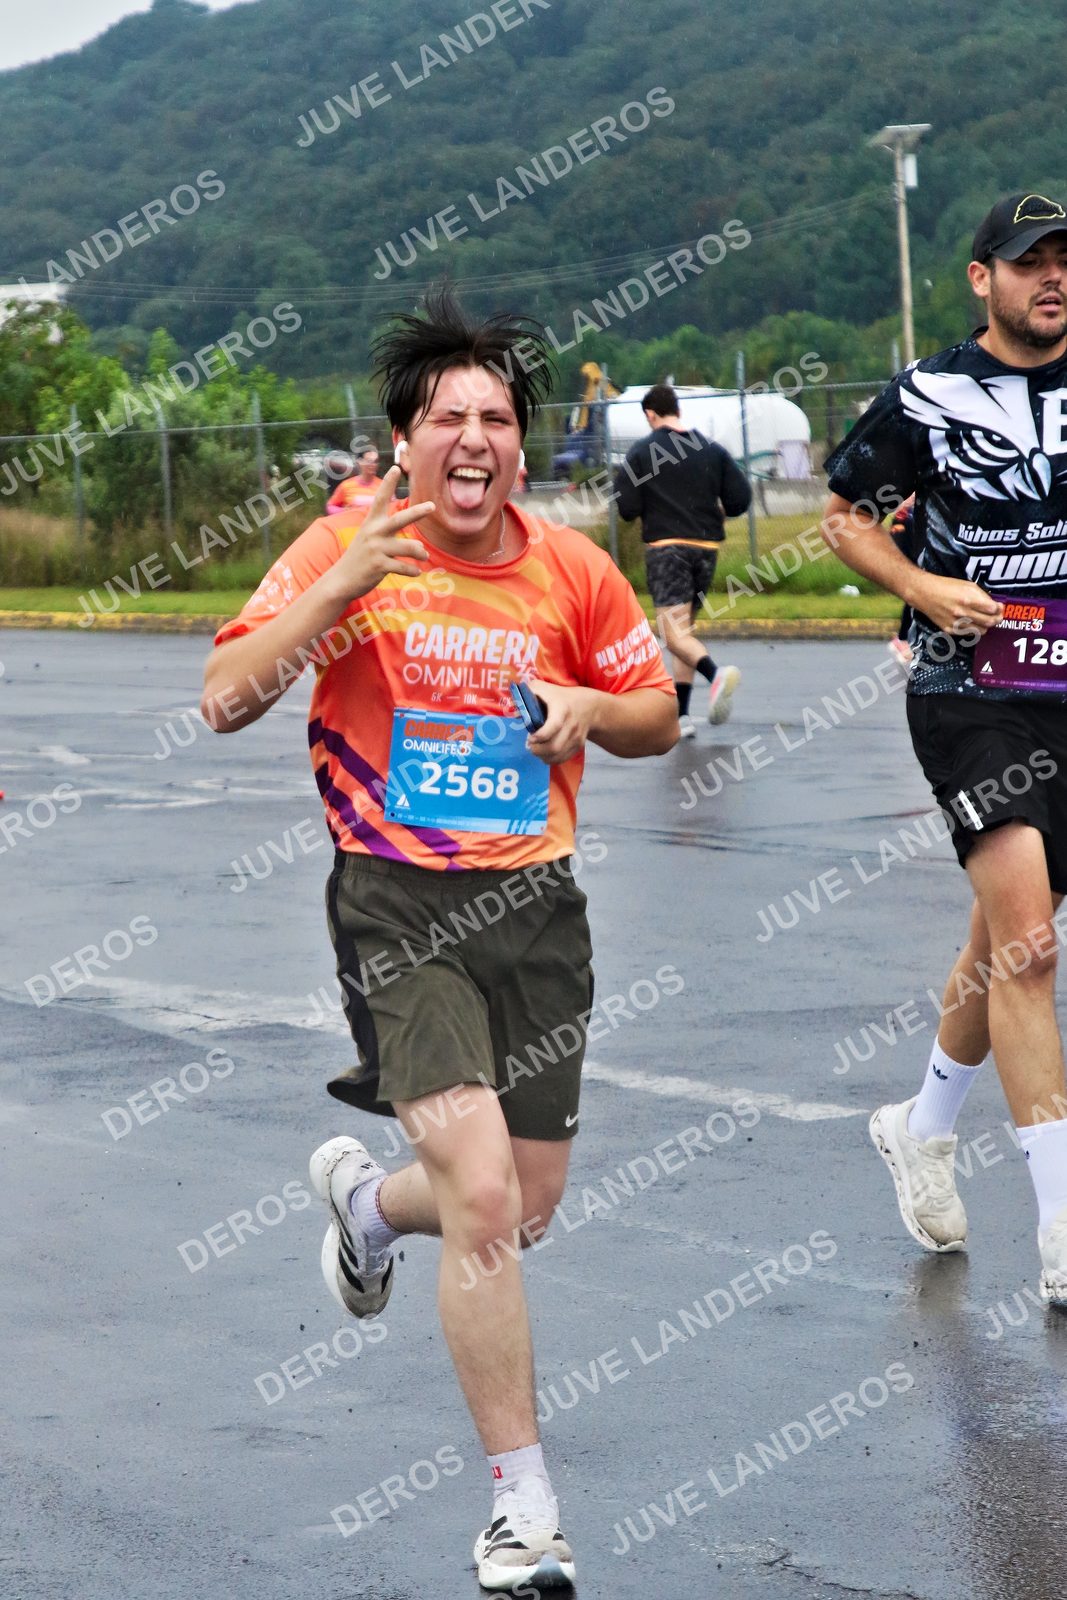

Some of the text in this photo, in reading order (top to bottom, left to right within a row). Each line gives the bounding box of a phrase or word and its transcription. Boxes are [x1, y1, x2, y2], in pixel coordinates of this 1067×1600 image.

[1003, 605, 1046, 620] RRERA
[996, 620, 1031, 631] MNILIFE
[404, 622, 540, 665] CARRERA
[402, 662, 511, 691] OMNILIFE
[463, 694, 477, 704] 10K
[403, 738, 457, 754] OMNILIFE
[419, 761, 520, 801] 2568
